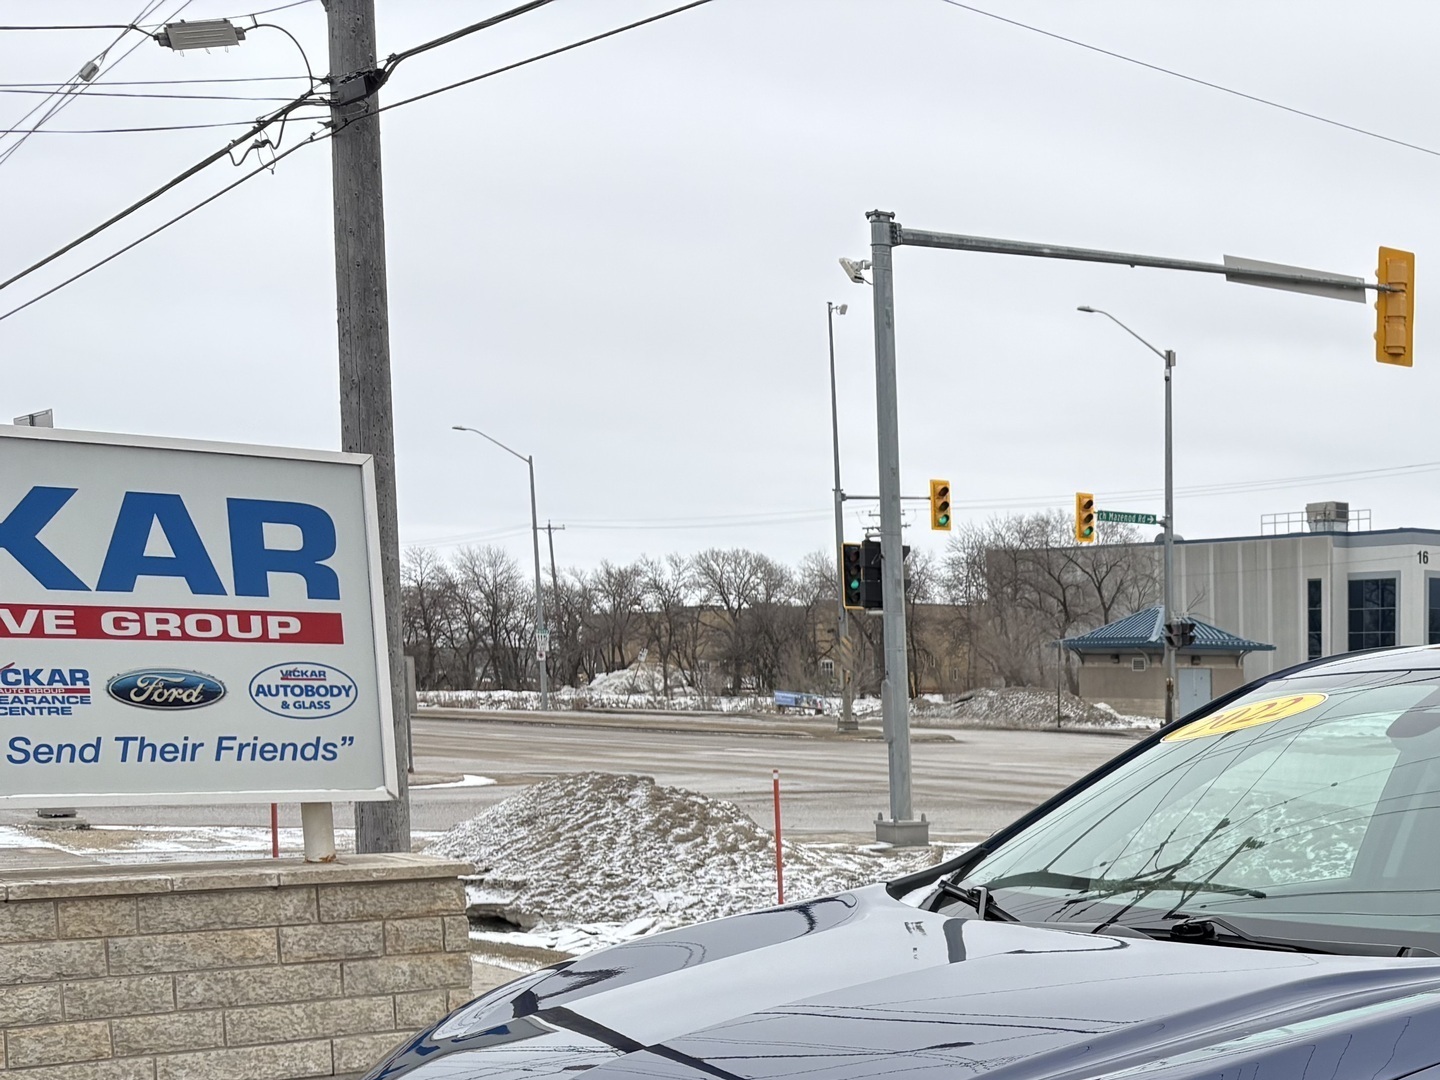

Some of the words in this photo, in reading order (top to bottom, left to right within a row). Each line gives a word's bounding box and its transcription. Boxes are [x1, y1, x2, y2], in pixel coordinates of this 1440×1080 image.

[0, 486, 341, 600] KAR
[1416, 550, 1429, 564] 16
[100, 610, 302, 639] GROUP
[280, 669, 327, 678] VICKAR
[129, 674, 205, 703] Ford
[254, 684, 353, 698] AUTOBODY
[280, 700, 290, 710] &
[293, 700, 331, 710] GLASS
[1179, 695, 1304, 738] 2022
[6, 736, 102, 765] Send
[113, 736, 205, 763] Their
